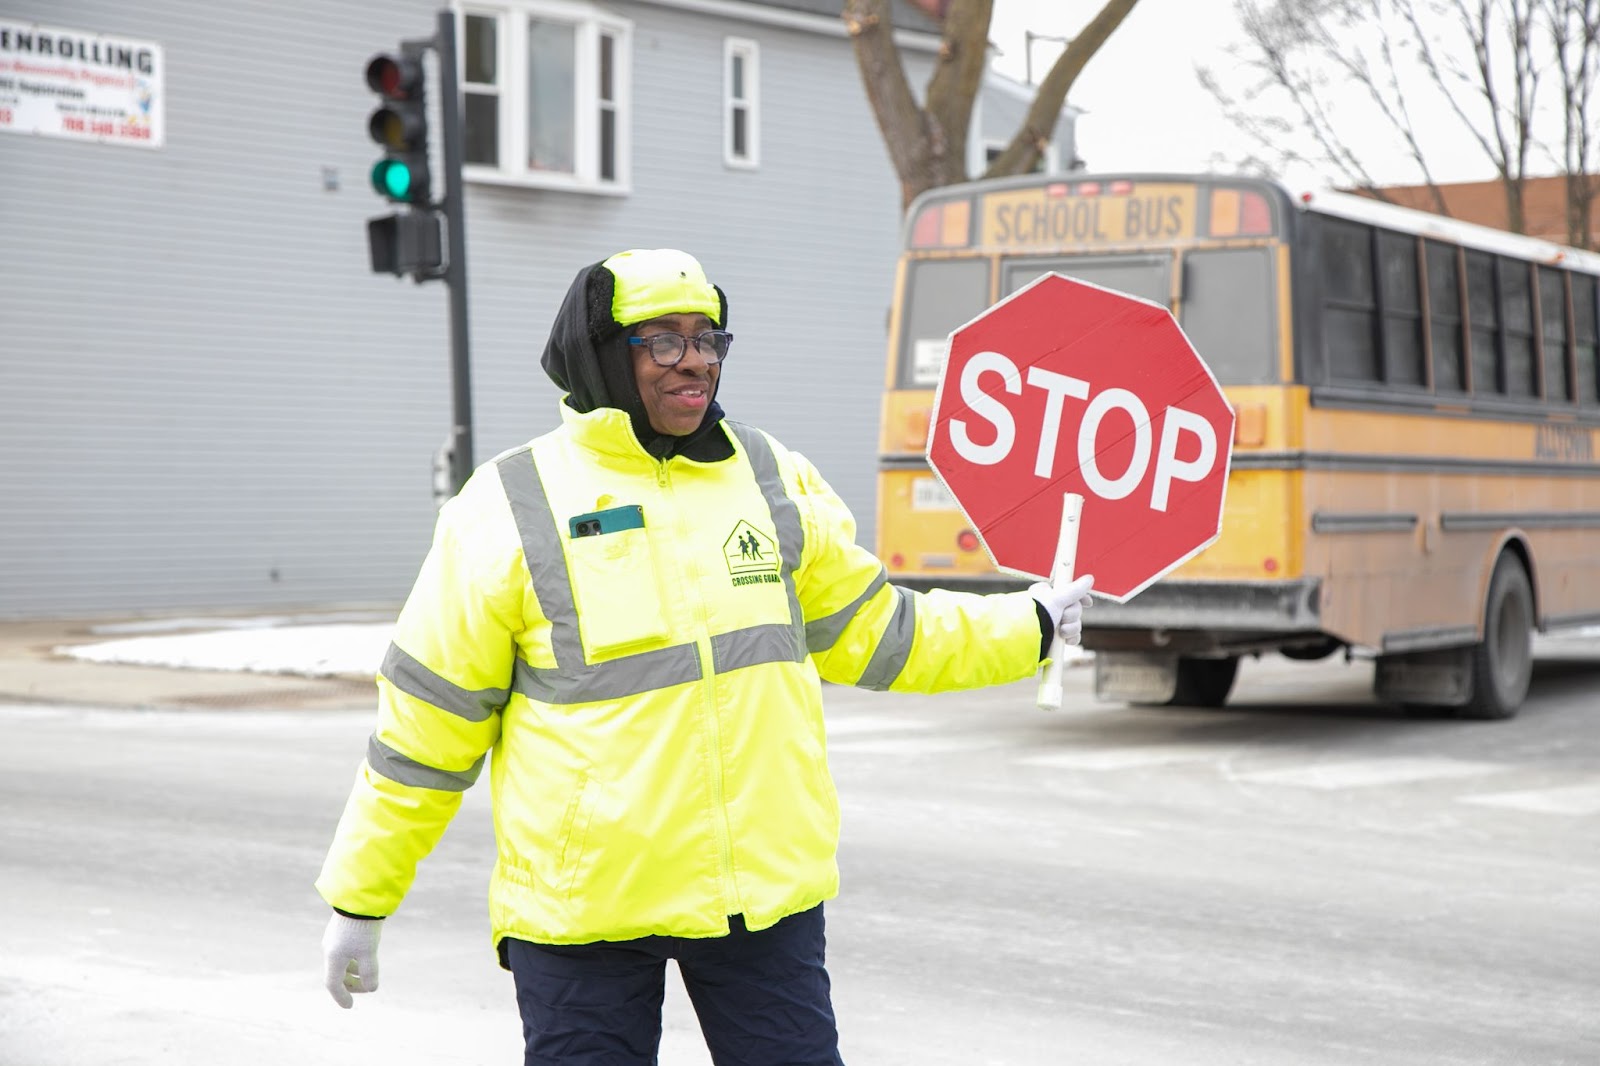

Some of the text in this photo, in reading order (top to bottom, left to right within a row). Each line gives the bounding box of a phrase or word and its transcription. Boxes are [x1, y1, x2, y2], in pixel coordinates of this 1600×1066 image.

[0, 29, 153, 75] ENROLLING
[995, 195, 1184, 243] SCHOOL BUS
[949, 351, 1217, 512] STOP
[732, 575, 763, 587] CROSSING
